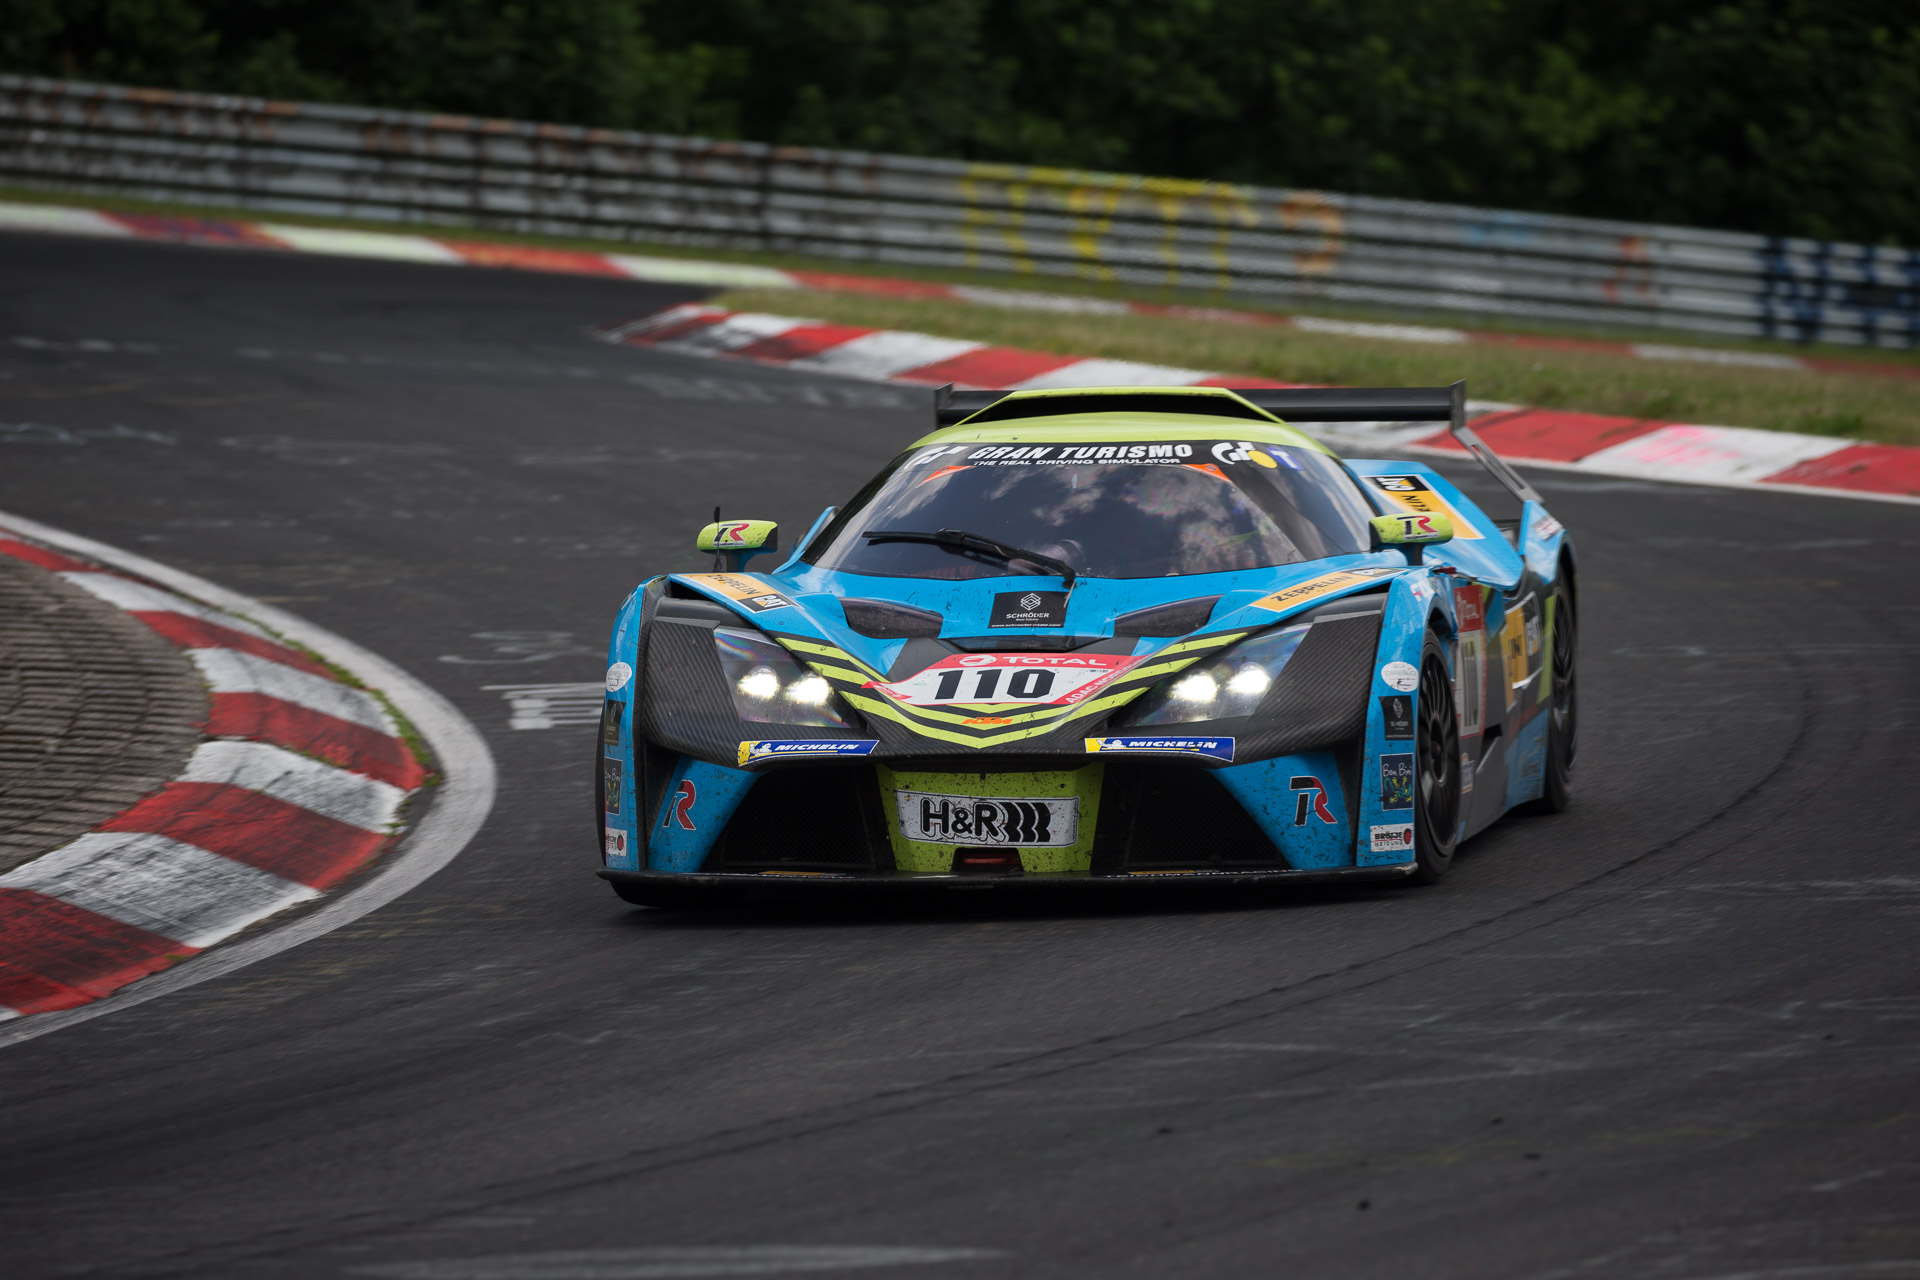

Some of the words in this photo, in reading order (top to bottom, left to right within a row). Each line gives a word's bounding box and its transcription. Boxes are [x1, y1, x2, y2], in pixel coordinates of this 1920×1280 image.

[966, 446, 1055, 460] GRAN
[1057, 444, 1193, 460] TURISMO
[1005, 611, 1050, 619] SCHRÖDER
[1002, 656, 1108, 667] TOTAL
[934, 668, 1056, 700] 110
[1128, 740, 1219, 749] MICHELIN
[1382, 763, 1398, 777] Bon
